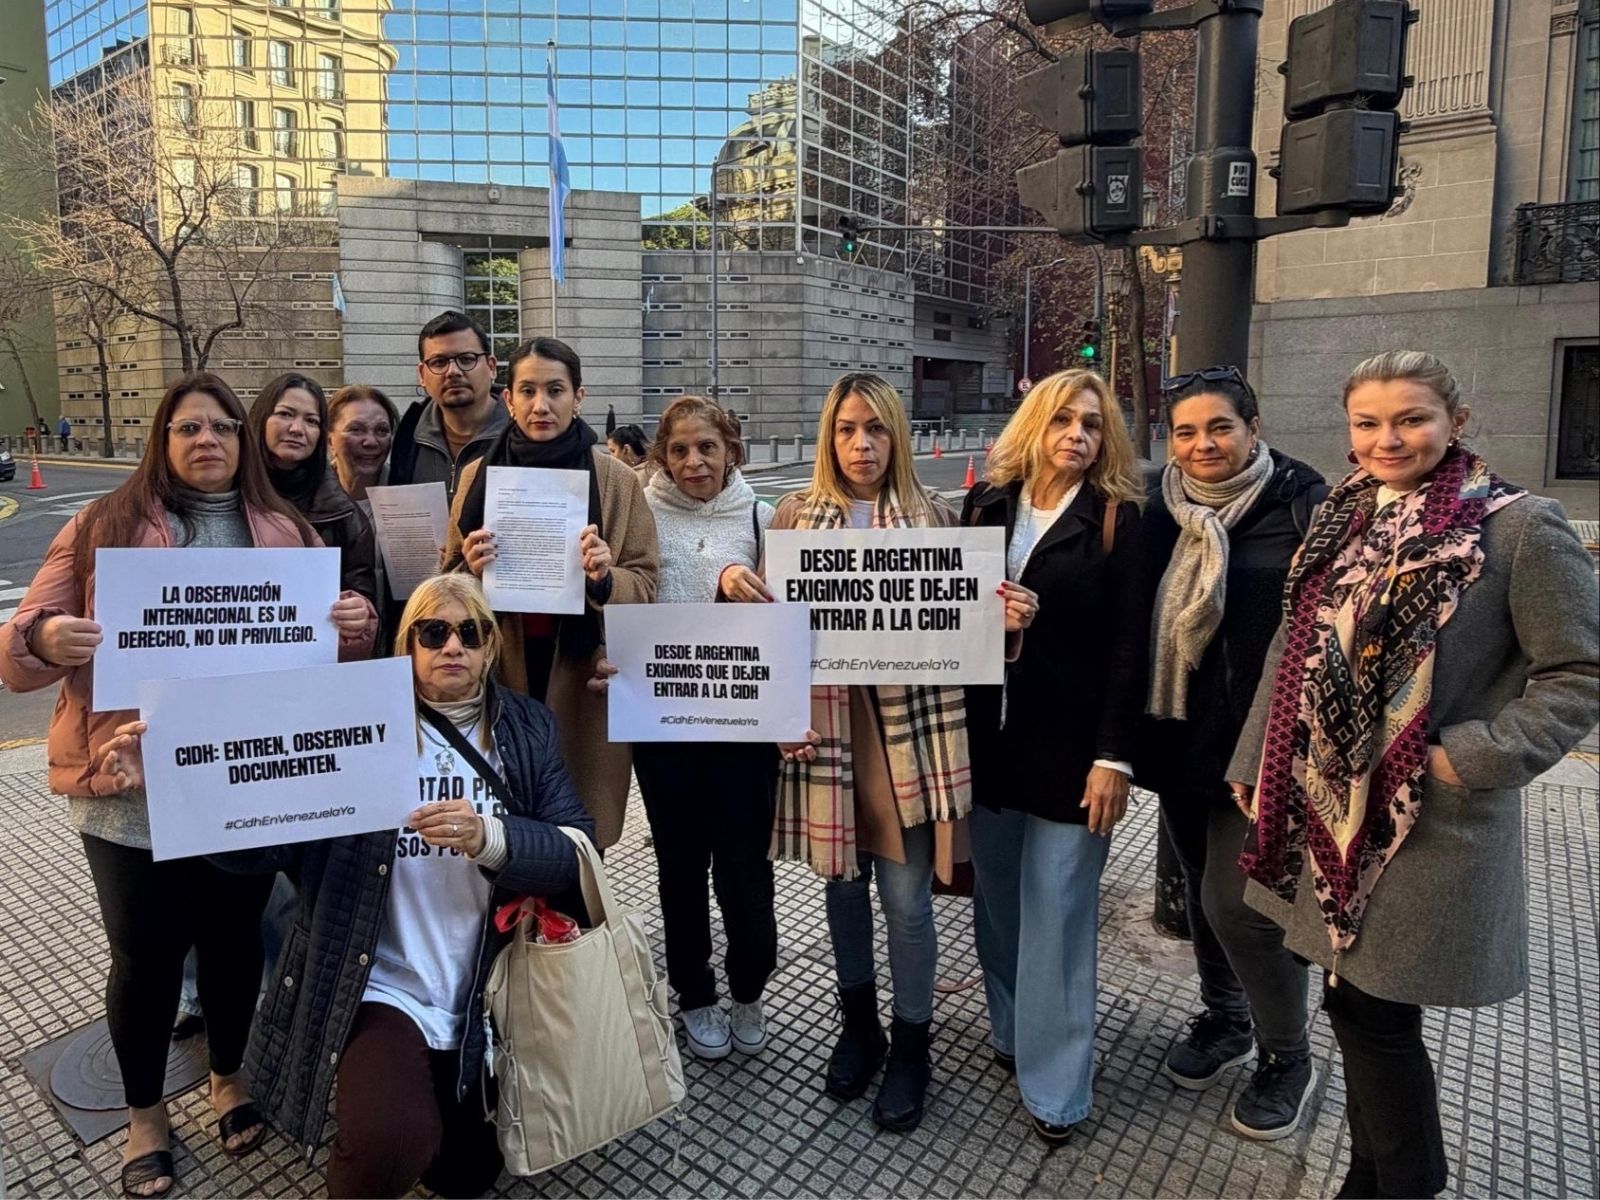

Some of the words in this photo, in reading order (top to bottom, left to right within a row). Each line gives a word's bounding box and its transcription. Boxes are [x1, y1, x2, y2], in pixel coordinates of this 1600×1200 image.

[801, 549, 857, 572] DESDE
[863, 548, 963, 571] ARGENTINA
[163, 587, 180, 603] LA
[185, 581, 281, 603] OBSERVACIÓN
[787, 579, 874, 602] EXIGIMOS
[880, 579, 914, 603] QUE
[920, 578, 978, 601] DEJEN
[144, 607, 254, 626] INTERNACIONAL
[258, 606, 274, 623] ES
[279, 606, 296, 622] UN
[811, 609, 866, 630] NTRAR
[872, 609, 884, 630] A
[891, 609, 912, 630] LA
[918, 608, 960, 630] CIDH
[119, 630, 189, 649] DERECHO,
[195, 629, 213, 646] NO
[219, 629, 237, 645] UN
[242, 626, 316, 644] PRIVILEGIO.
[655, 645, 691, 659] DESDE
[695, 645, 759, 661] ARGENTINA
[646, 663, 702, 678] EXIGIMOS
[706, 664, 728, 680] QUE
[733, 665, 769, 680] DEJEN
[811, 659, 959, 670] #CidhEnVenezuelaYa
[654, 682, 698, 697] ENTRAR
[701, 683, 710, 698] A
[713, 684, 727, 698] LA
[731, 684, 758, 699] CIDH
[660, 716, 758, 726] #CidhEnVenezuelaYa
[176, 744, 219, 766] CIDH:
[224, 736, 289, 758] ENTREN,
[293, 726, 372, 752] OBSERVEN
[376, 724, 385, 742] Y
[229, 754, 341, 784] DOCUMENTEN.
[224, 806, 355, 830] #CidhEnVenezuelaYa
